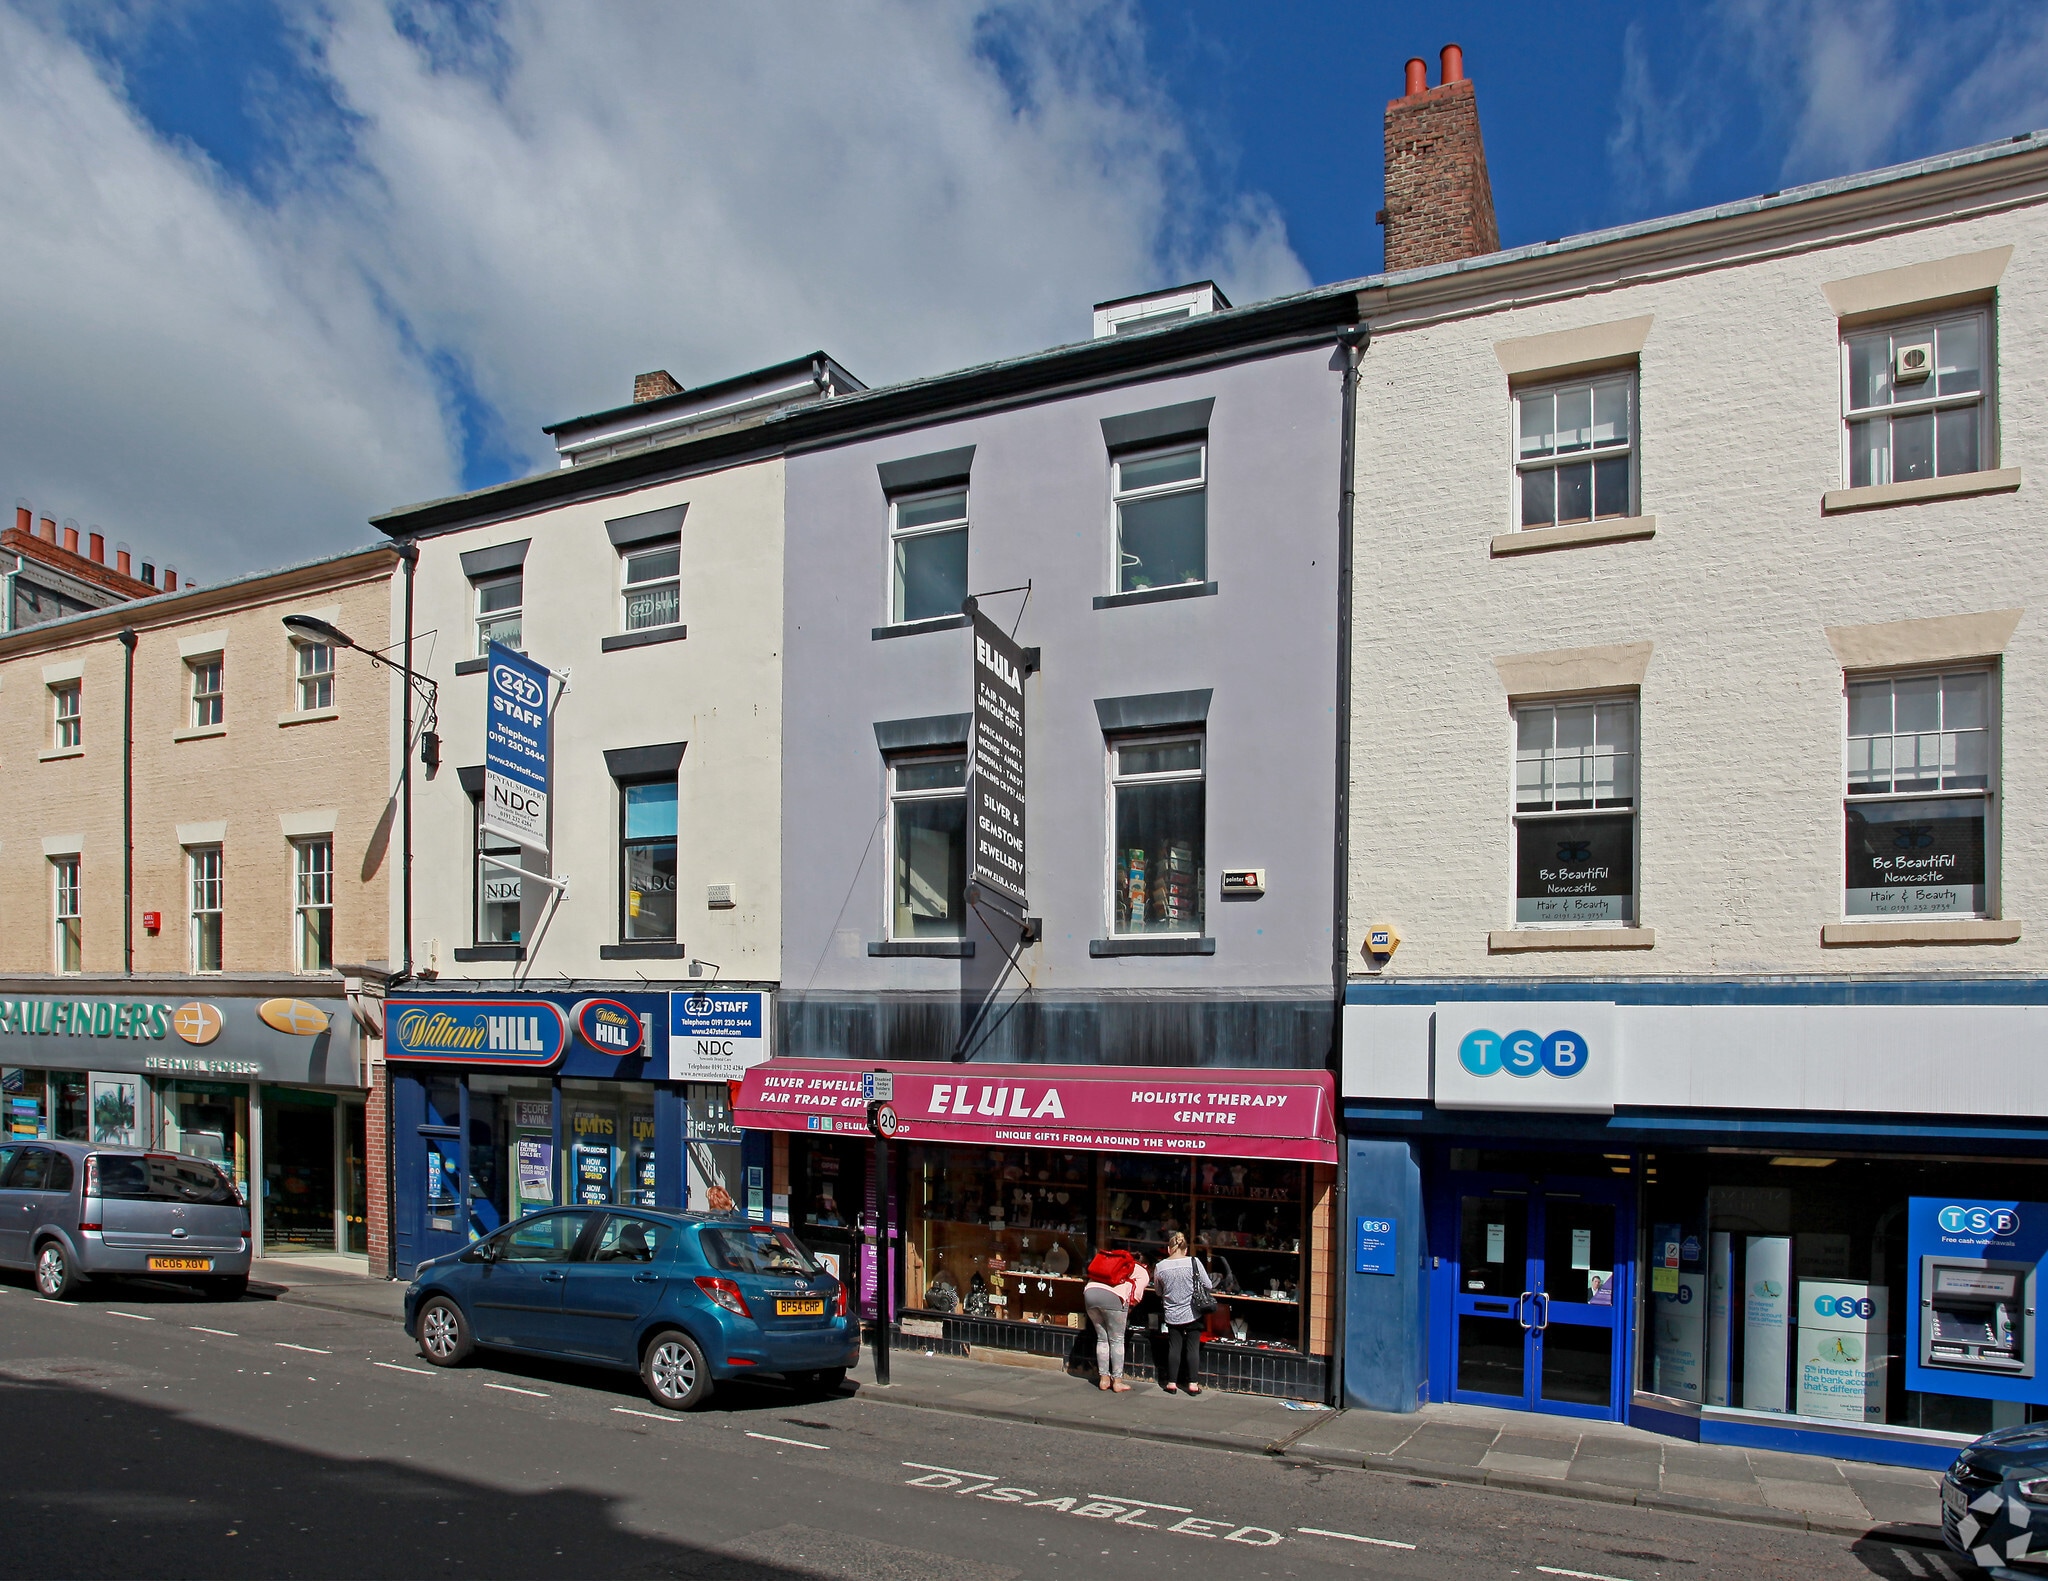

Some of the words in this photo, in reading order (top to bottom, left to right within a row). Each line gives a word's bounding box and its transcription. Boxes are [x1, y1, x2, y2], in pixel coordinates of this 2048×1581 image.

[632, 603, 650, 614] 247
[976, 635, 1022, 696] ELULA
[501, 672, 536, 699] 247
[980, 682, 997, 703] FAIR
[999, 696, 1019, 721] TRADE
[493, 695, 542, 729] STAFF
[978, 694, 1004, 722] UNIQUE
[1005, 715, 1023, 737] GIFTS
[497, 722, 537, 748] Telephone
[979, 721, 1003, 745] AFRICAN
[1003, 738, 1022, 759] CRAFTS
[489, 731, 506, 745] 0191
[507, 739, 523, 753] 230
[525, 747, 546, 762] 5444
[978, 735, 1000, 757] INCENSE
[1004, 754, 1023, 774] ANGELS
[975, 763, 1000, 786] HEALING
[977, 750, 1002, 773] BUDDHAS
[1006, 770, 1024, 788] TAROT
[488, 772, 514, 788] DENTAL
[515, 785, 546, 801] SURGERY
[494, 785, 539, 817] NDC
[984, 793, 1011, 822] SILVER
[1012, 813, 1019, 827] &
[979, 815, 1023, 852] GEMSTONE
[979, 840, 1024, 875] JEWELLERY
[1872, 857, 1893, 869] Be
[1895, 855, 1955, 869] Beautiful
[1225, 875, 1245, 884] pointer
[1540, 869, 1557, 880] Be
[1559, 867, 1609, 880] Beautiful
[1884, 871, 1944, 883] Newcastle
[1547, 883, 1597, 893] Newcastle
[1870, 891, 1895, 901] Hair
[1901, 890, 1908, 902] &
[1916, 889, 1956, 904] Beauty
[1537, 900, 1557, 910] Hair
[1563, 900, 1569, 911] &
[1575, 900, 1609, 913] Beauty
[689, 1002, 709, 1012] 247
[715, 1001, 748, 1013] STAFF
[595, 1008, 629, 1027] William
[681, 1019, 710, 1027] Telephone
[397, 1008, 489, 1050] William
[489, 1016, 543, 1051] HILL
[595, 1023, 629, 1047] HILL
[697, 1040, 733, 1056] NDC
[764, 1077, 804, 1089] SILVER
[866, 1075, 872, 1084] P
[760, 1092, 792, 1104] FAIR
[794, 1093, 837, 1107] TRADE
[841, 1097, 876, 1108] GIFT
[927, 1083, 1066, 1119] ELULA
[1131, 1091, 1201, 1105] HOLISTIC
[1207, 1093, 1288, 1107] THERAPY
[521, 1103, 548, 1114] SCORE
[528, 1115, 546, 1125] WIN.
[574, 1114, 614, 1136] LIMITS
[881, 1114, 895, 1128] 20
[1174, 1110, 1236, 1125] CENTRE
[995, 1130, 1032, 1141] UNIQUE
[1034, 1131, 1060, 1142] GIFTS
[1063, 1133, 1092, 1144] FROM
[1095, 1135, 1140, 1146] AROUND
[1143, 1137, 1164, 1148] THE
[1166, 1138, 1206, 1149] WORLD
[584, 1171, 602, 1179] SPEND
[582, 1191, 598, 1199] LONG
[1250, 1186, 1288, 1200] RELAX
[1941, 1236, 1957, 1244] Free
[1976, 1239, 2015, 1247] withdrawals
[781, 1301, 802, 1312] BP54
[804, 1301, 819, 1312] GHP
[1817, 1366, 1853, 1377] interest
[1855, 1369, 1874, 1378] from
[1804, 1374, 1819, 1382] the
[1821, 1375, 1843, 1384] bank
[1845, 1378, 1879, 1388] account
[1804, 1382, 1828, 1392] that's
[905, 1473, 1284, 1546] DISABLED
